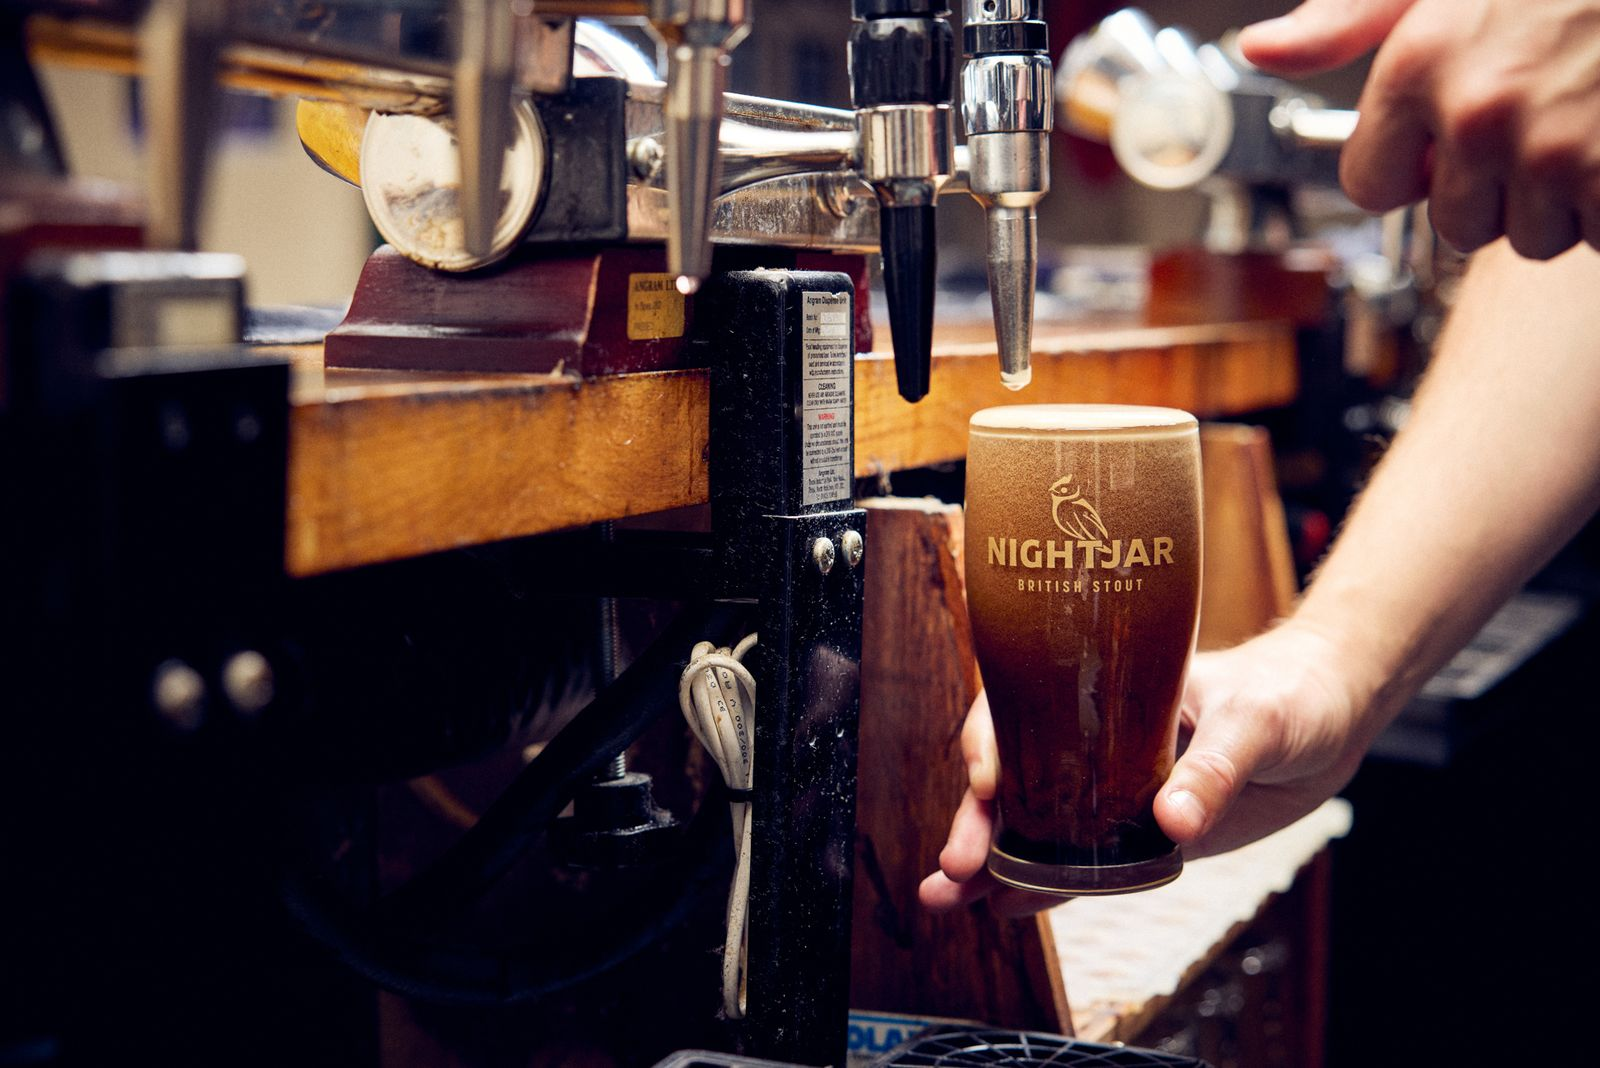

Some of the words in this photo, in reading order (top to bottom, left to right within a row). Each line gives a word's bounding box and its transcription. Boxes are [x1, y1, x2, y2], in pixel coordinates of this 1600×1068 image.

[634, 280, 664, 291] ANGRAM
[665, 280, 679, 291] LT
[807, 296, 821, 306] Angram
[988, 537, 1175, 569] NIGHTJAR
[1018, 579, 1082, 593] BRITISH
[1093, 578, 1143, 592] STOUT
